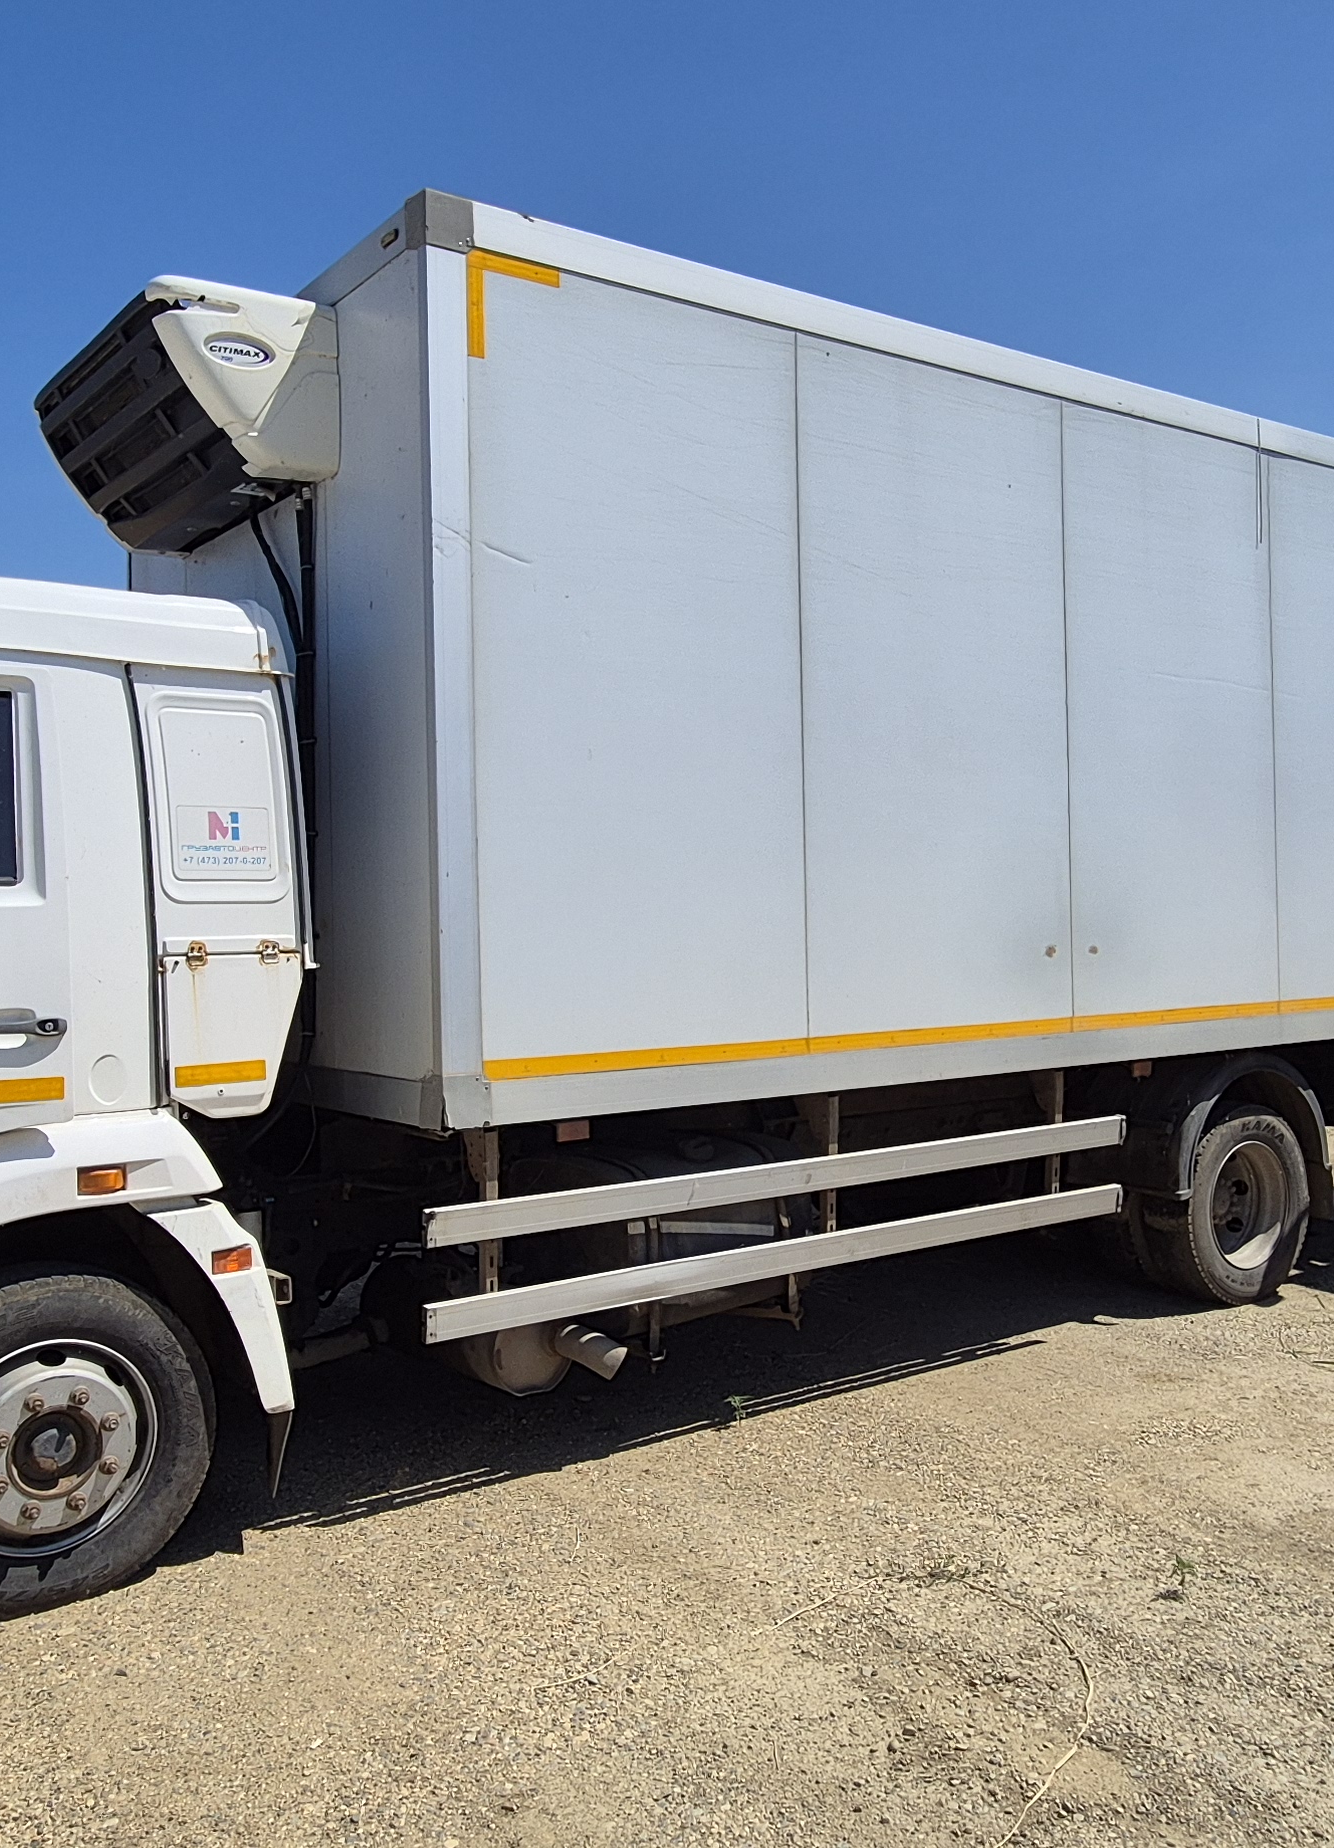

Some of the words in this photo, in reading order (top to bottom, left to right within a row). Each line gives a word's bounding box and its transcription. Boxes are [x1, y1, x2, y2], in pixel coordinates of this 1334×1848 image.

[209, 345, 261, 359] CITIMAX
[181, 845, 267, 853] ГРУЗАВТОЦЕНТР
[183, 856, 194, 864] +7
[197, 856, 220, 866] (473)
[223, 856, 267, 865] 207-0-207
